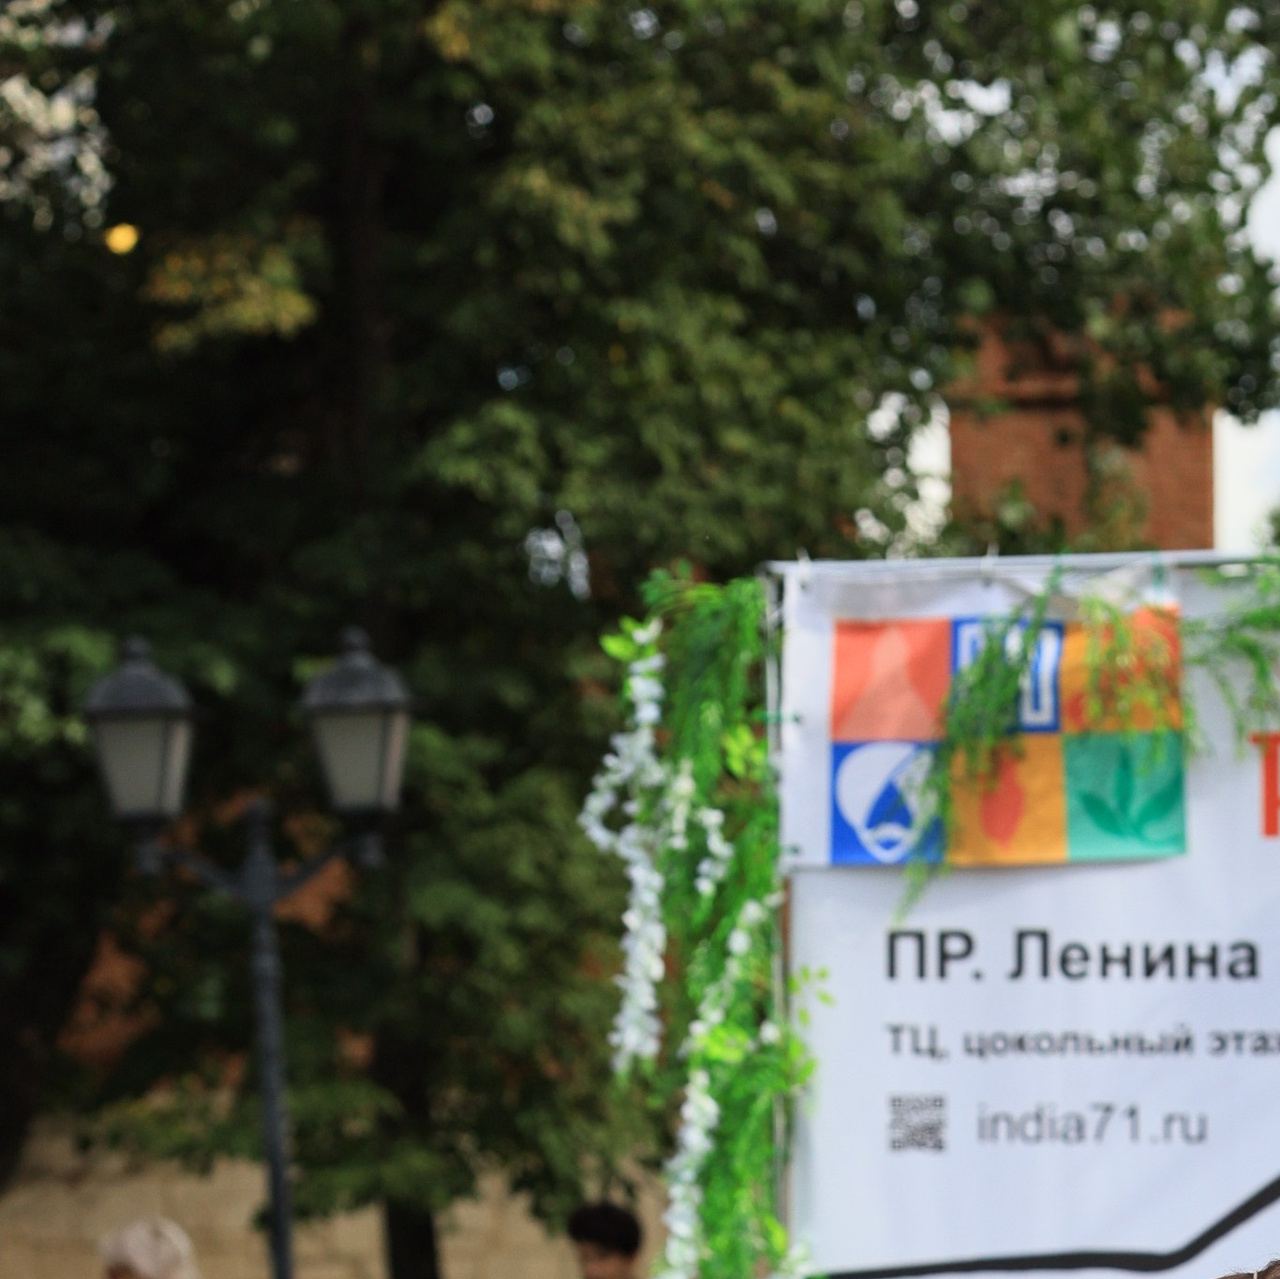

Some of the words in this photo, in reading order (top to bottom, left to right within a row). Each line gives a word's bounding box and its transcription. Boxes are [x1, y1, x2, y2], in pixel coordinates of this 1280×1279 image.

[884, 928, 983, 982] ПР.
[1008, 928, 1260, 982] Ленина
[962, 1026, 1194, 1060] цокольный
[976, 1102, 1209, 1148] india71.ru
